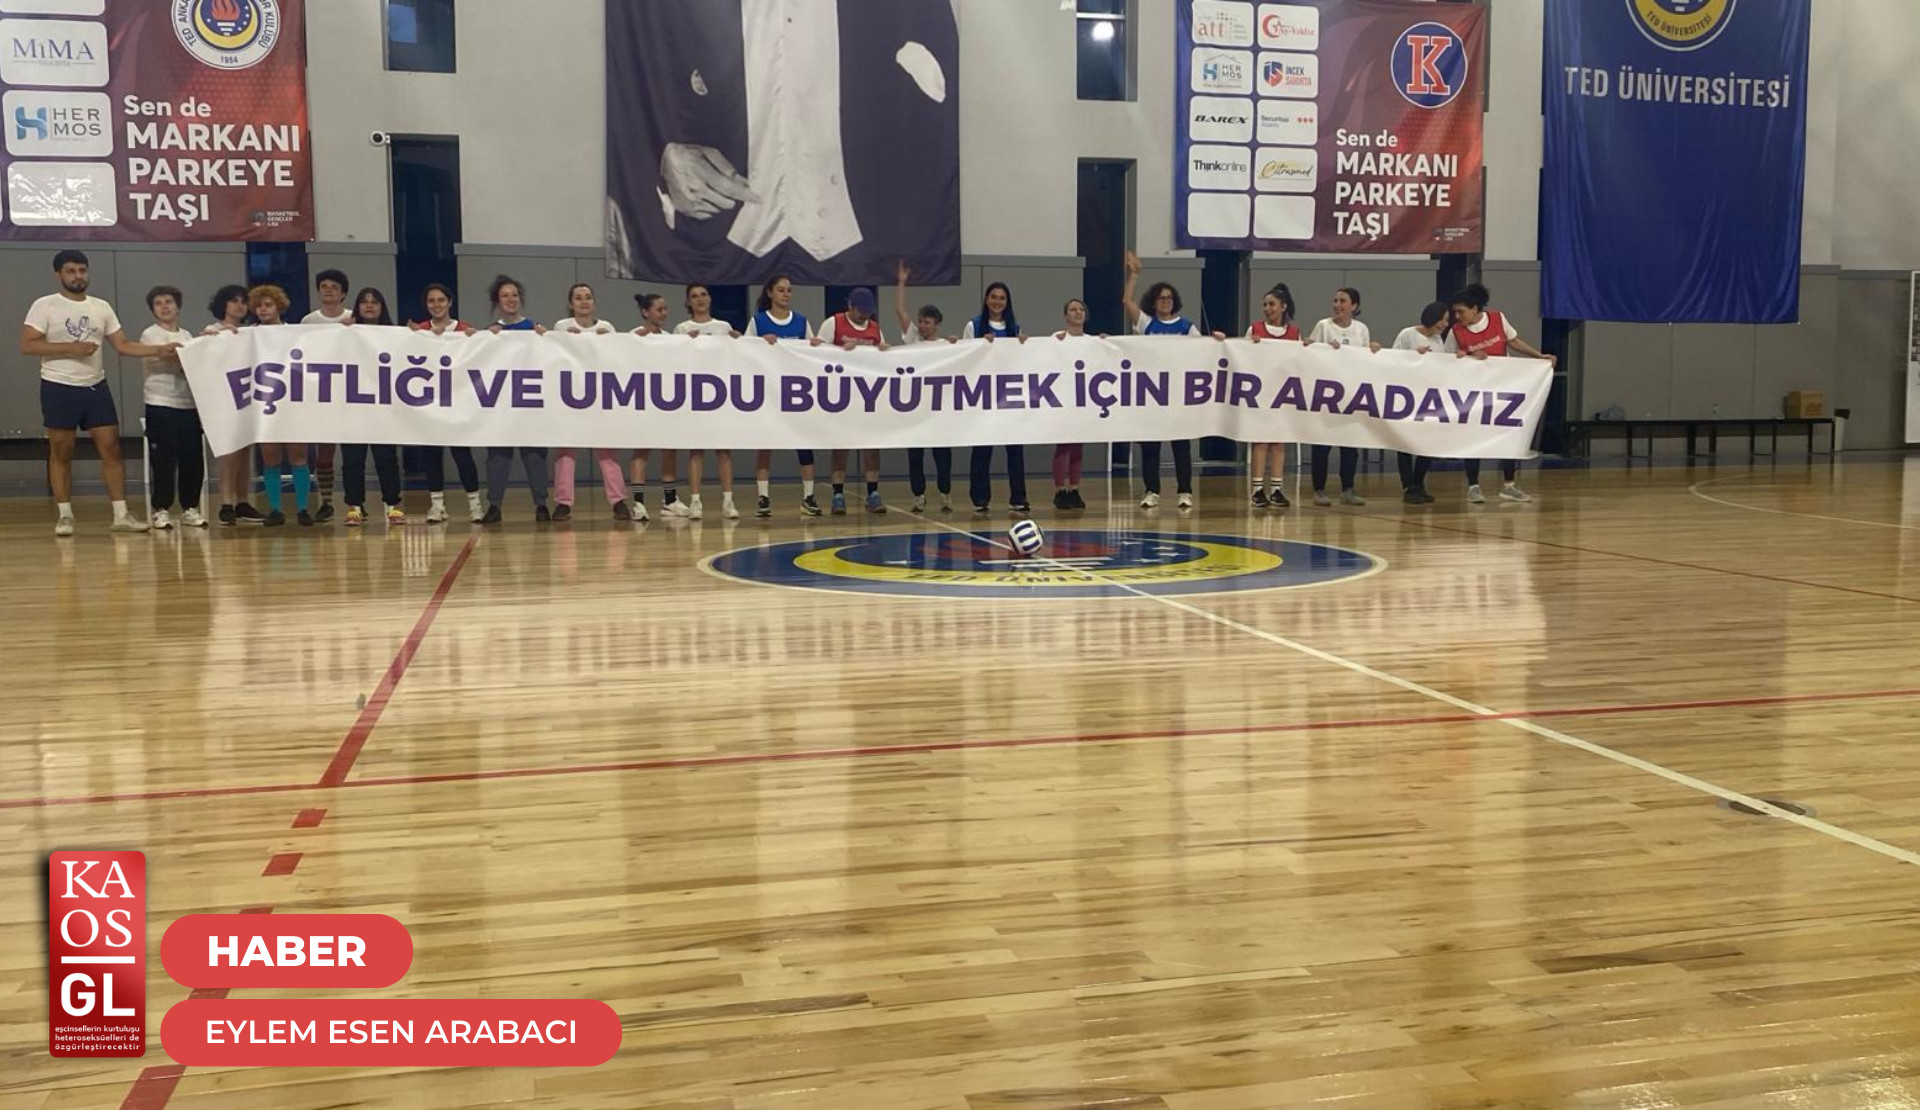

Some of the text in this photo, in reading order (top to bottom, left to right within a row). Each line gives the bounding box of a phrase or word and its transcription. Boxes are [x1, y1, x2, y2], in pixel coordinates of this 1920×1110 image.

[181, 27, 197, 47] TED
[1407, 35, 1452, 95] K
[1564, 65, 1790, 108] TED ÜNİVERSİTESİ
[53, 107, 100, 121] HER
[124, 94, 212, 118] Sen de
[1195, 115, 1248, 124] BAREX
[54, 122, 102, 137] MOS
[126, 121, 300, 152] MARKANI
[1336, 128, 1399, 148] Sen de
[128, 157, 295, 187] PARKEYE
[1336, 151, 1458, 178] MARKANI
[1335, 181, 1451, 207] PARKEYE
[129, 193, 210, 228] TAŞI
[1332, 211, 1390, 241] TAŞI
[226, 348, 1527, 428] EŞİTLİĞİ VE UMUDU BÜYÜTMEK İÇİN BİR ARADAYIZ
